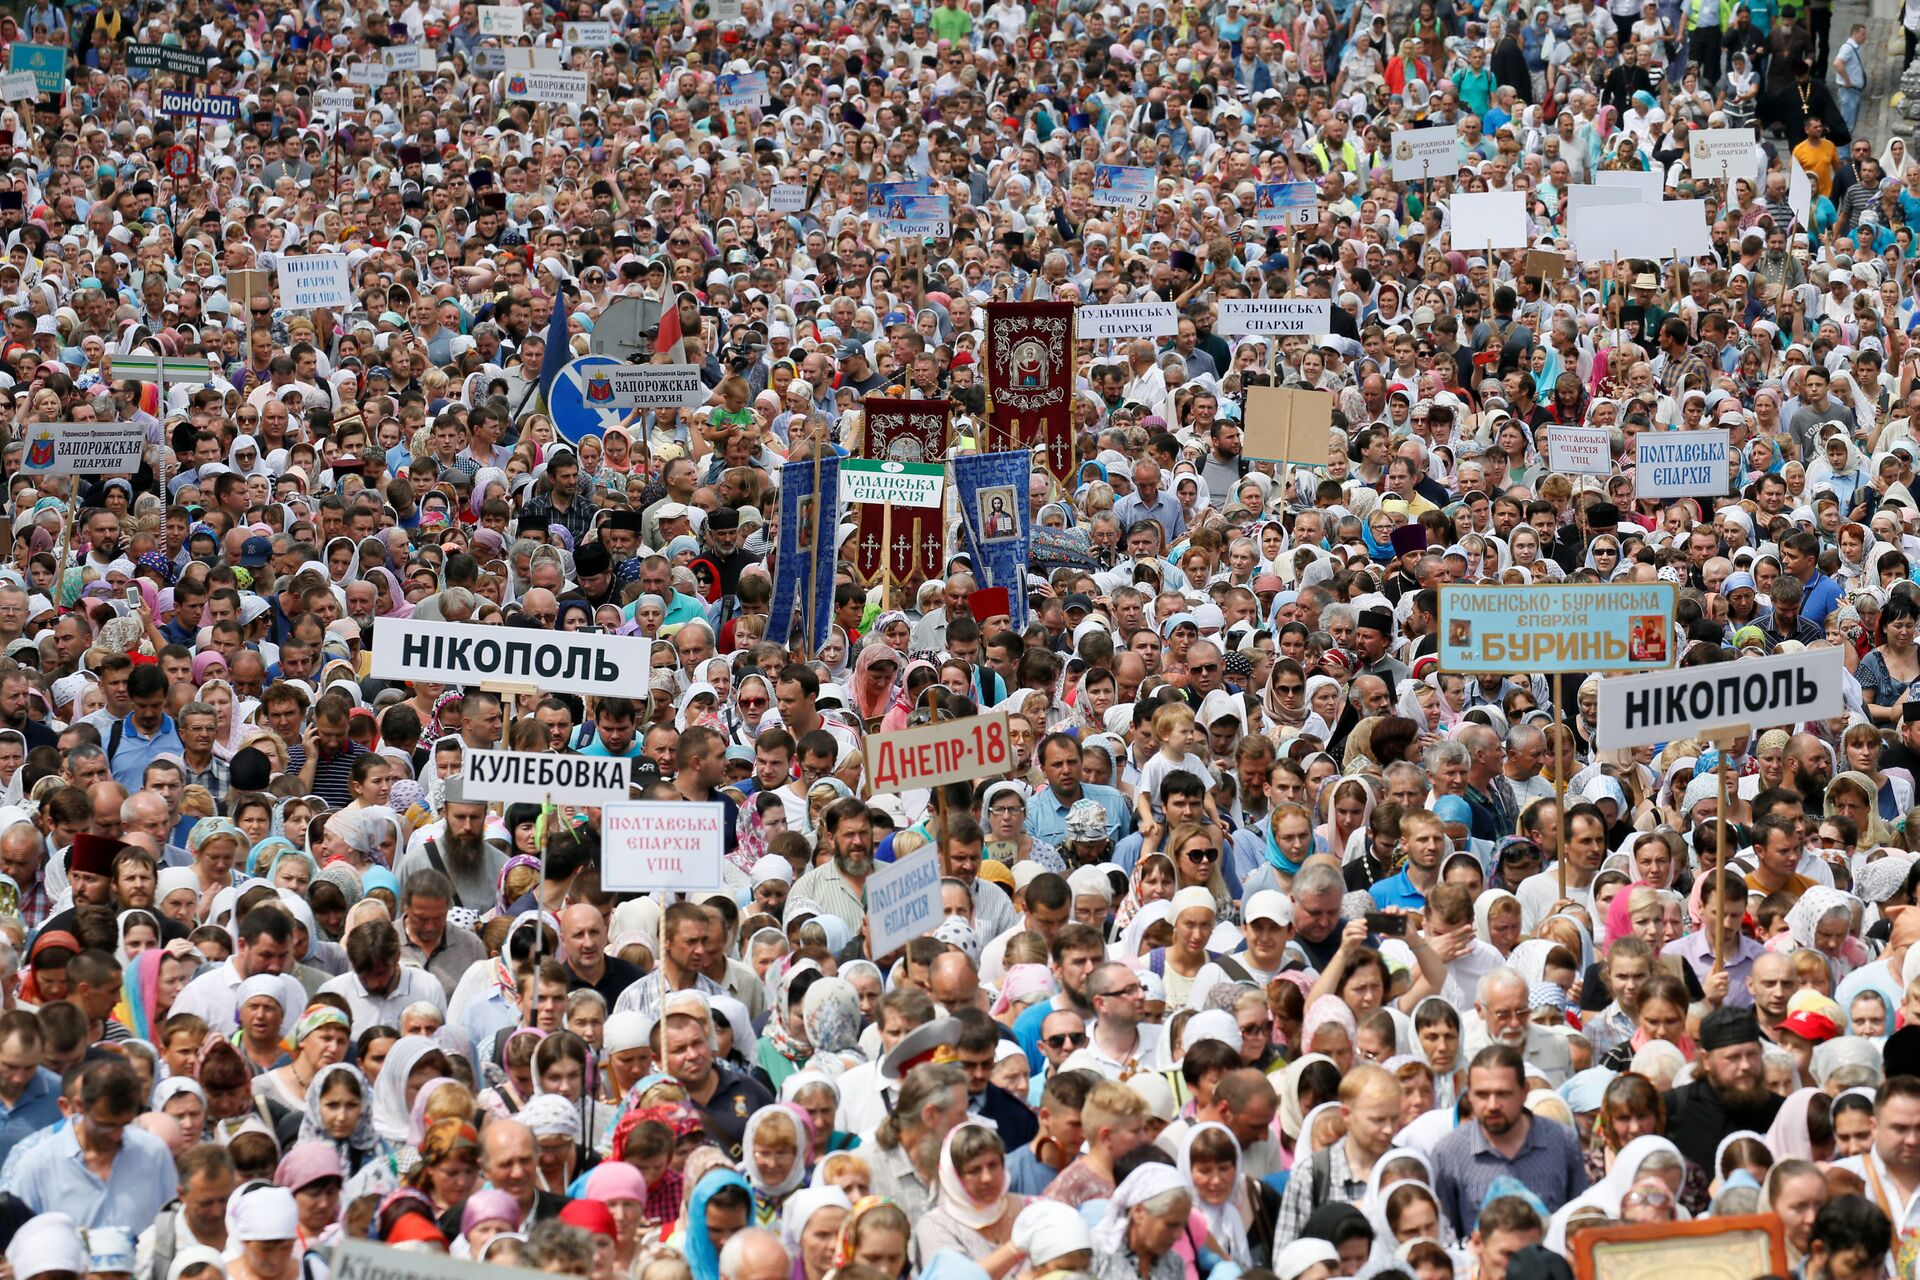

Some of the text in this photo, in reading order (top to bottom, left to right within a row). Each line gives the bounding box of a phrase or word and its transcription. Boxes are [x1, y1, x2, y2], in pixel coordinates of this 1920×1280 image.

[528, 80, 586, 92] ЗАПОРОЖСКАЯ
[162, 95, 232, 116] КОНОТОП
[1422, 158, 1429, 169] 3
[1721, 159, 1728, 169] 3
[1138, 194, 1148, 208] 2
[1300, 209, 1309, 222] 5
[935, 222, 945, 236] 3
[1080, 307, 1172, 319] ТУЛЬЧИНСЬКА
[1224, 303, 1323, 314] ТУЛЬЧИНСЬКА
[1099, 324, 1152, 334] ЄПАРХІЯ
[1246, 320, 1304, 330] ЄПАРХІЯ
[615, 379, 698, 393] ЗАПОРОЖСКАЯ
[1551, 433, 1607, 444] ПОЛТАВСЬКА
[58, 440, 142, 455] ЗАПОРОЖСКАЯ
[1560, 444, 1599, 454] ЄПАРХІЯ
[1640, 442, 1726, 463] ПОЛТАВСЬКА
[846, 474, 935, 491] УМАНСЬКА
[1653, 466, 1711, 486] ЄПАРХІЯ
[854, 487, 924, 502] ЄПАРХІЯ
[1482, 631, 1627, 662] БУРИНЬ
[402, 633, 620, 682] НІКОПОЛЬ
[1626, 667, 1818, 729] НІКОПОЛЬ
[470, 754, 624, 789] КУЛЕБОВКА
[609, 816, 718, 831] ПОЛТАВСЬКА
[627, 836, 701, 850] ЄПАРХІЯ
[647, 857, 683, 874] УПЦ
[871, 859, 938, 914] ПОЛТАВСЬКА
[884, 894, 929, 937] ЄПАРХІЯ
